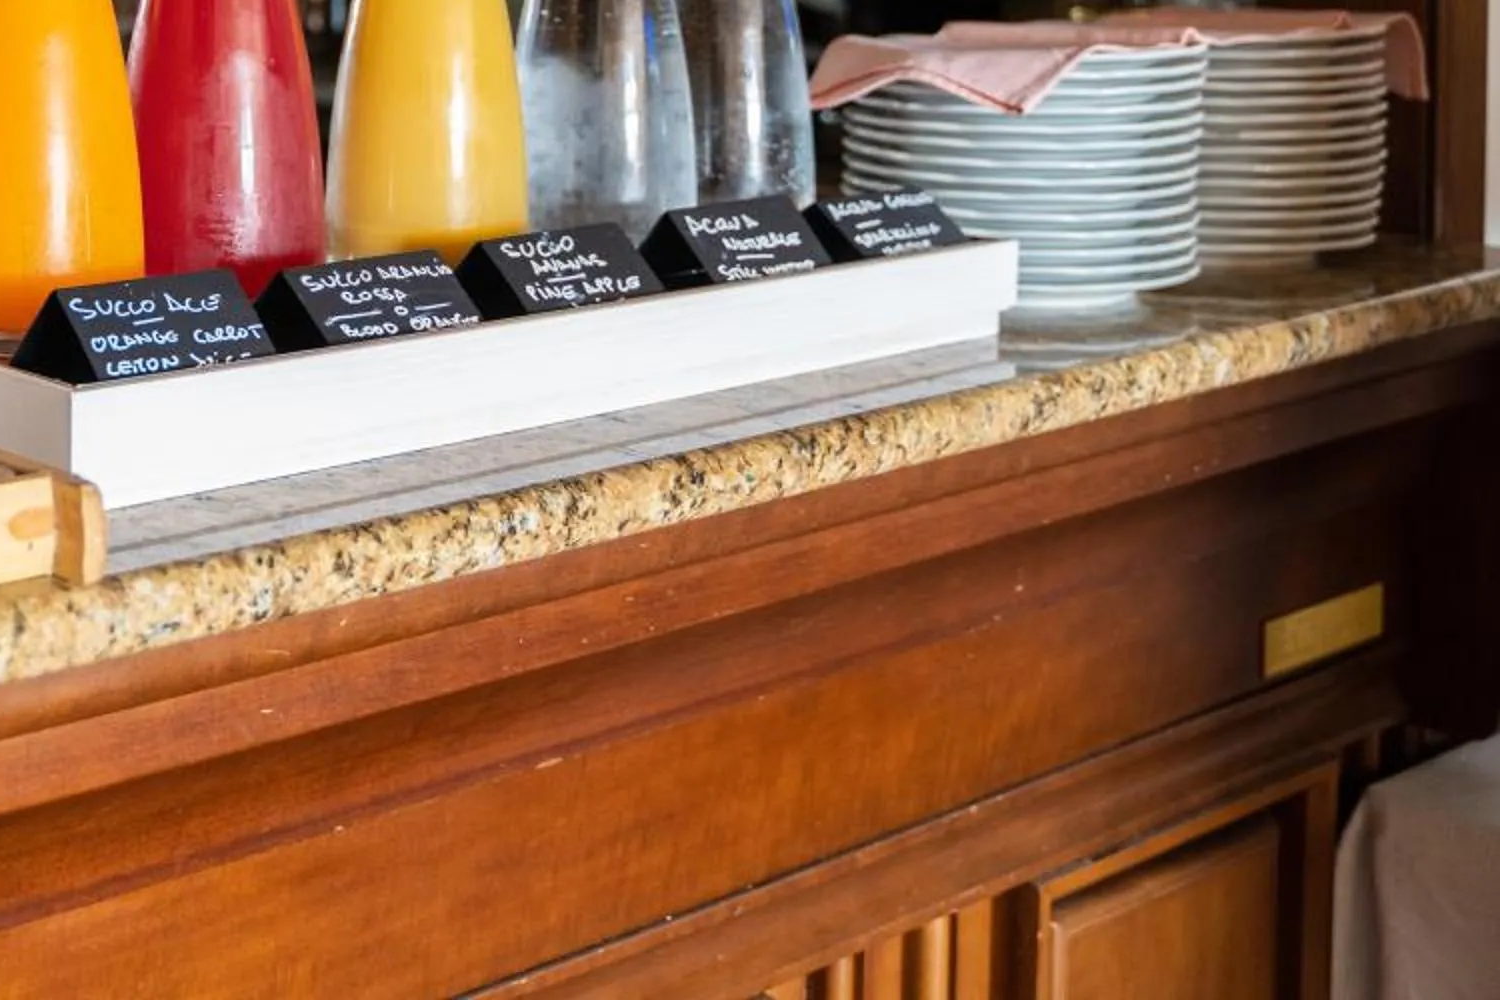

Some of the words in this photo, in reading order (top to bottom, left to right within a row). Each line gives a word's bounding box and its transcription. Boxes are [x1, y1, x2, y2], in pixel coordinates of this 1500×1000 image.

[68, 296, 155, 321] SUCCO
[163, 292, 221, 314] ACE
[340, 287, 408, 304] ROSSA
[90, 329, 180, 353] ORANGE
[340, 322, 399, 338] BLOOD
[106, 354, 180, 377] LEMON
